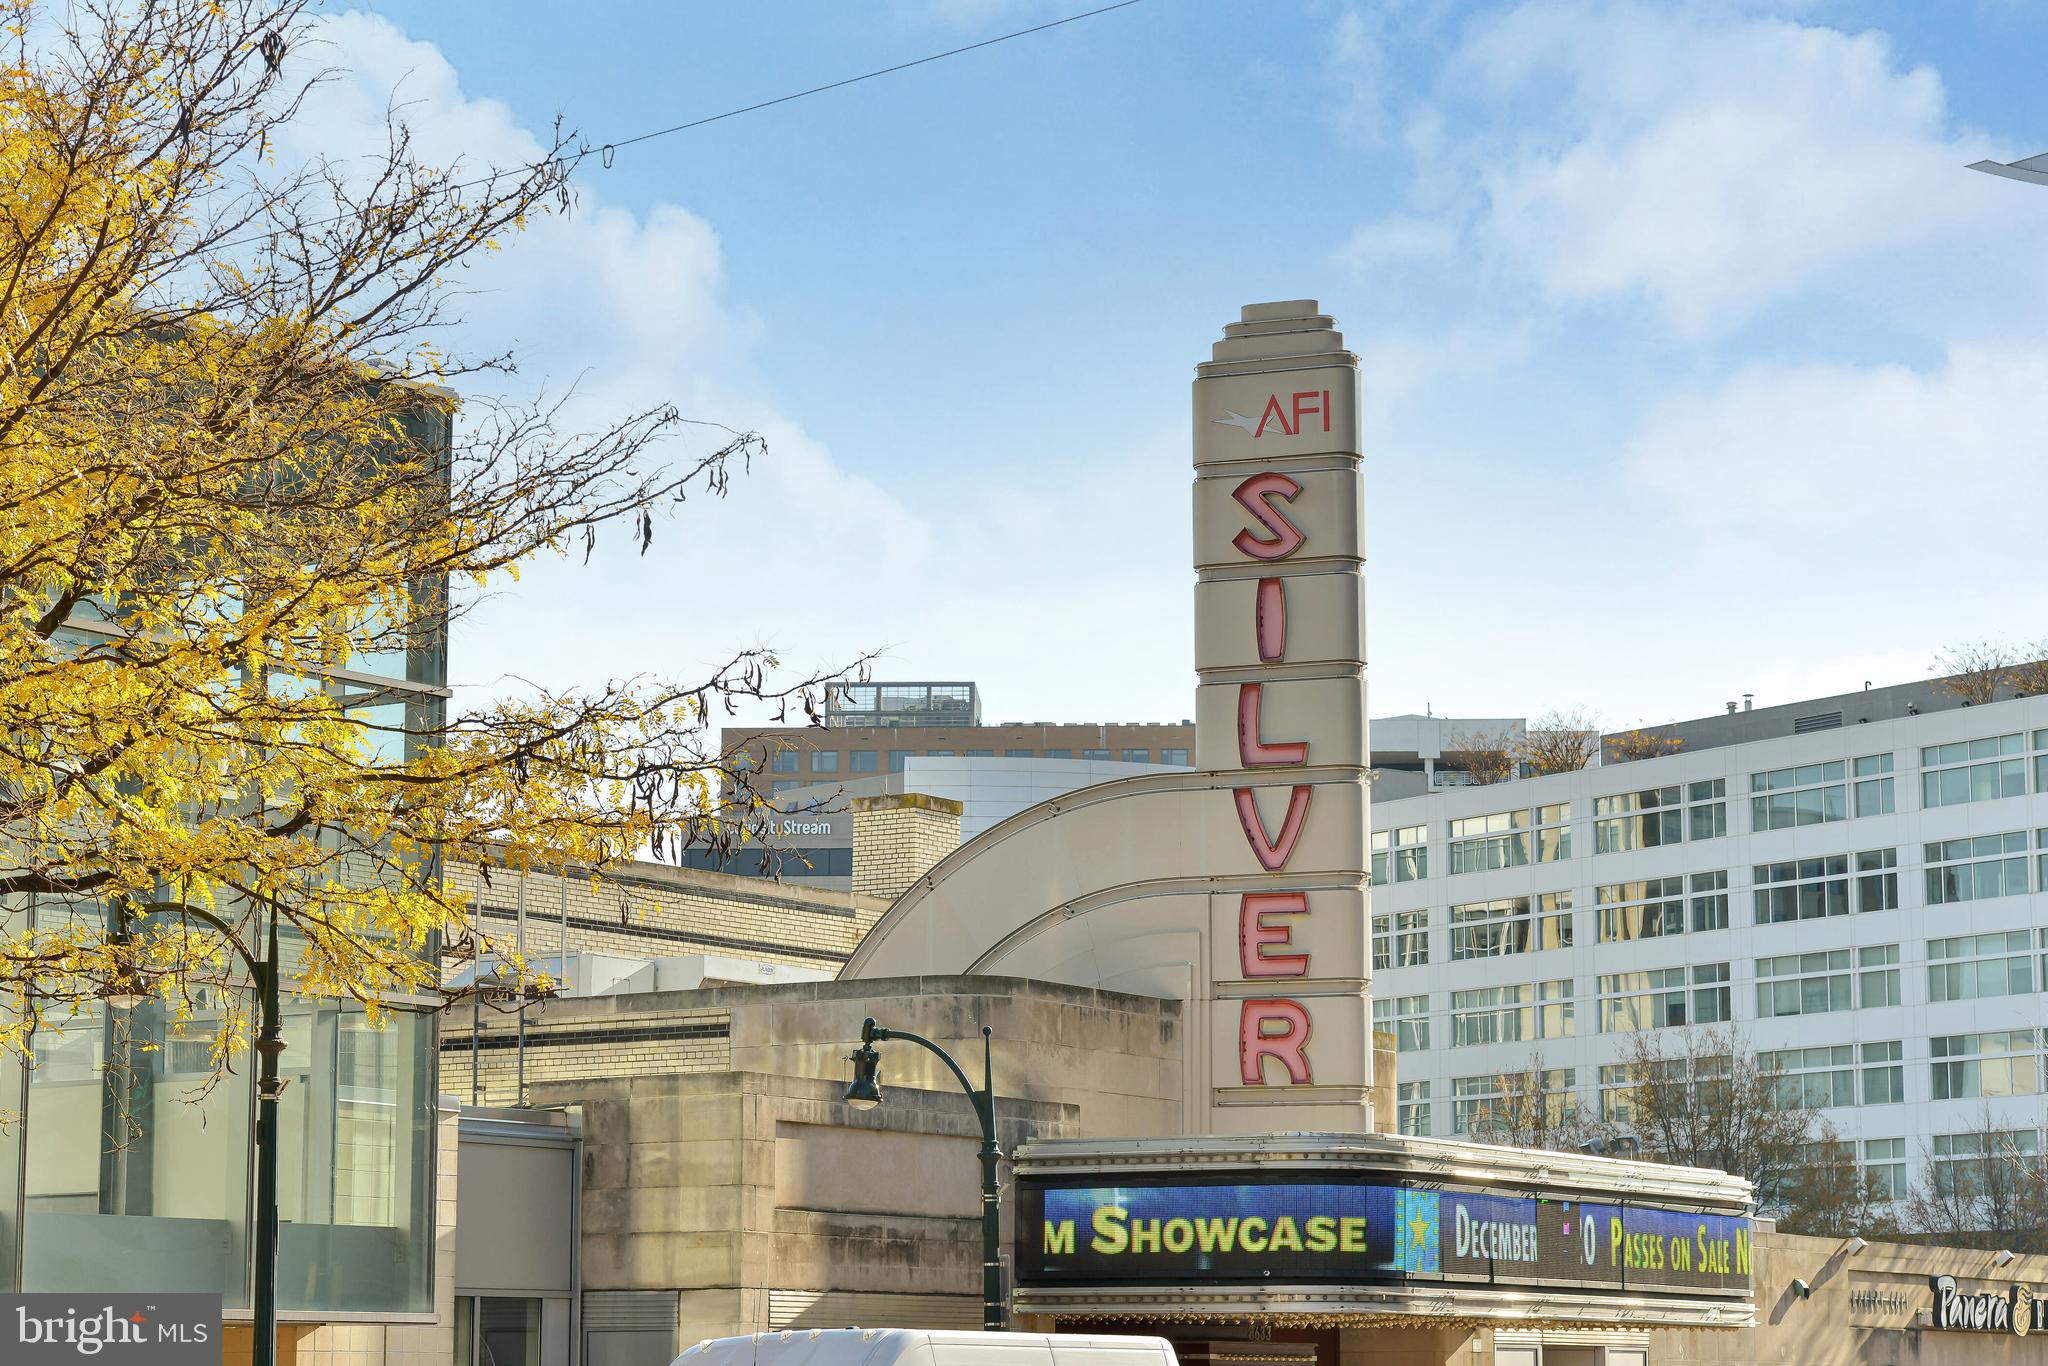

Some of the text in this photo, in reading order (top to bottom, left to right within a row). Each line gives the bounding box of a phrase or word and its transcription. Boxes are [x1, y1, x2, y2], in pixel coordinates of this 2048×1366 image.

[1254, 390, 1330, 438] AFI
[1231, 471, 1314, 1086] SILVER
[1091, 1204, 1368, 1255] SHOWCASE
[1455, 1203, 1538, 1263] DECEMBER
[1610, 1216, 1665, 1272] PASSES
[1670, 1236, 1691, 1273] ON
[1697, 1224, 1730, 1275] SALE
[1937, 1275, 2008, 1331] Panera
